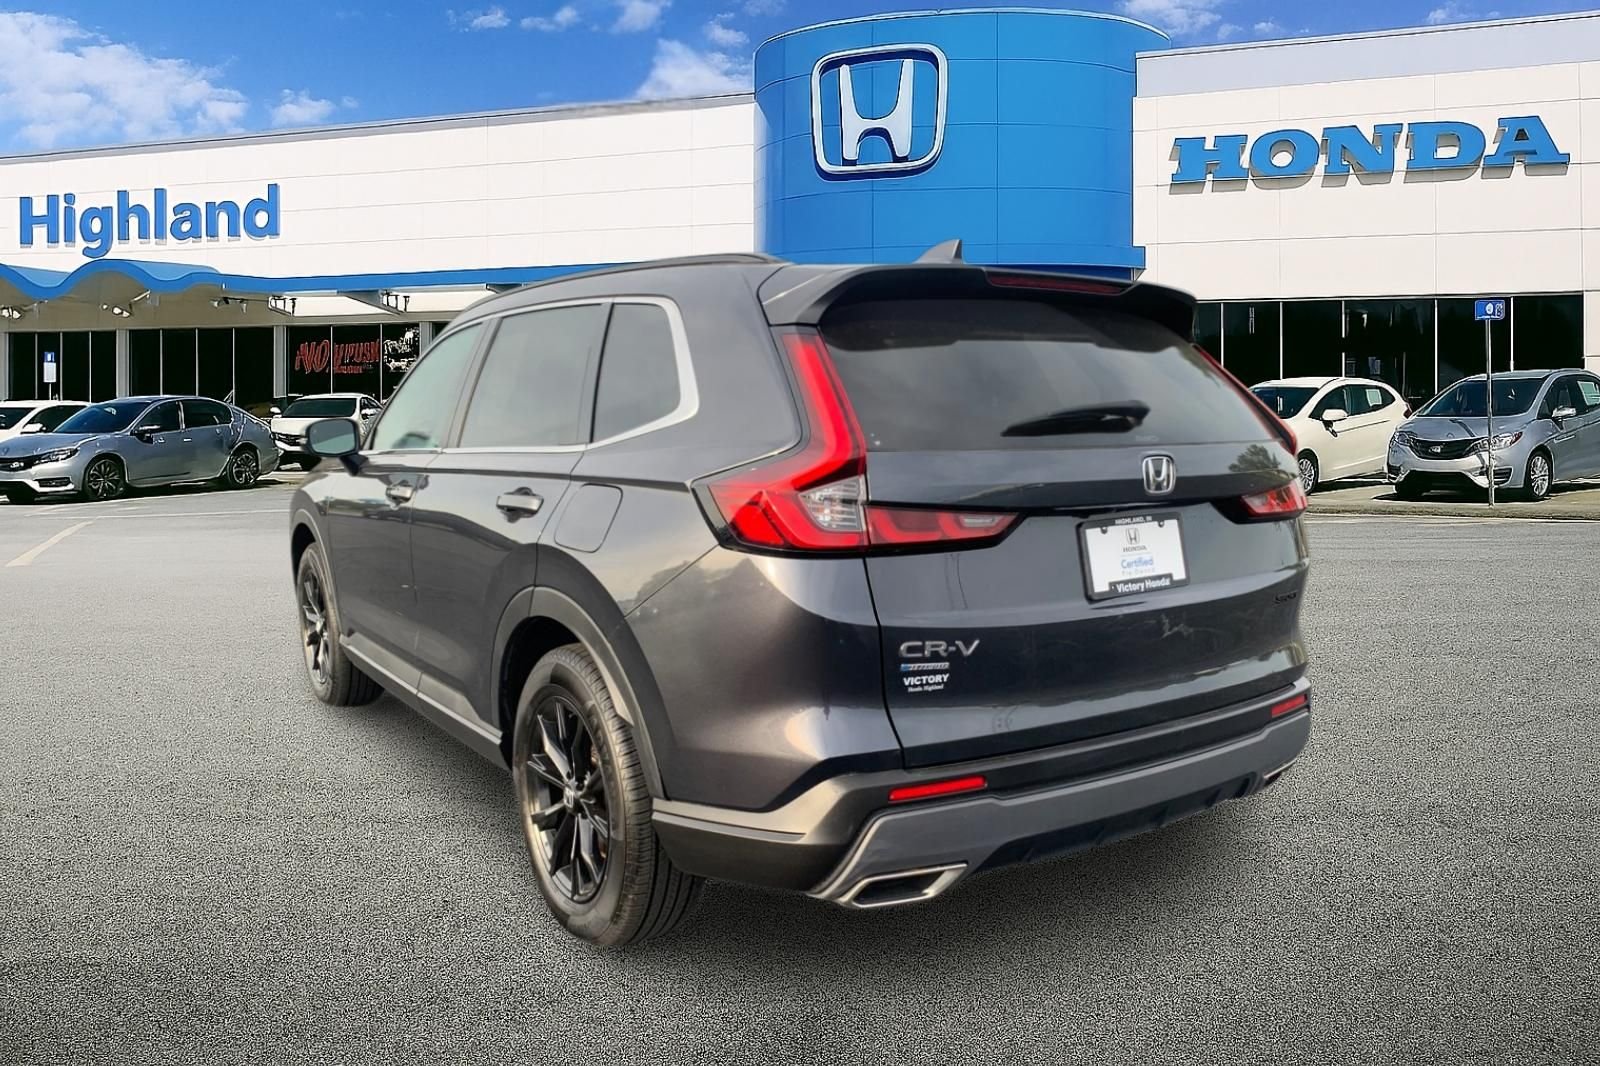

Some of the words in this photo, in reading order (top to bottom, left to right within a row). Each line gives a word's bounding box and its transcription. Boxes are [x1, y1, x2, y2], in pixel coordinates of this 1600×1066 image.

[1170, 115, 1571, 184] HONDA
[19, 183, 280, 258] Highland
[1116, 580, 1145, 593] Victory
[1145, 577, 1171, 589] Honda
[899, 639, 980, 658] CR-V
[903, 673, 950, 686] VICTORY
